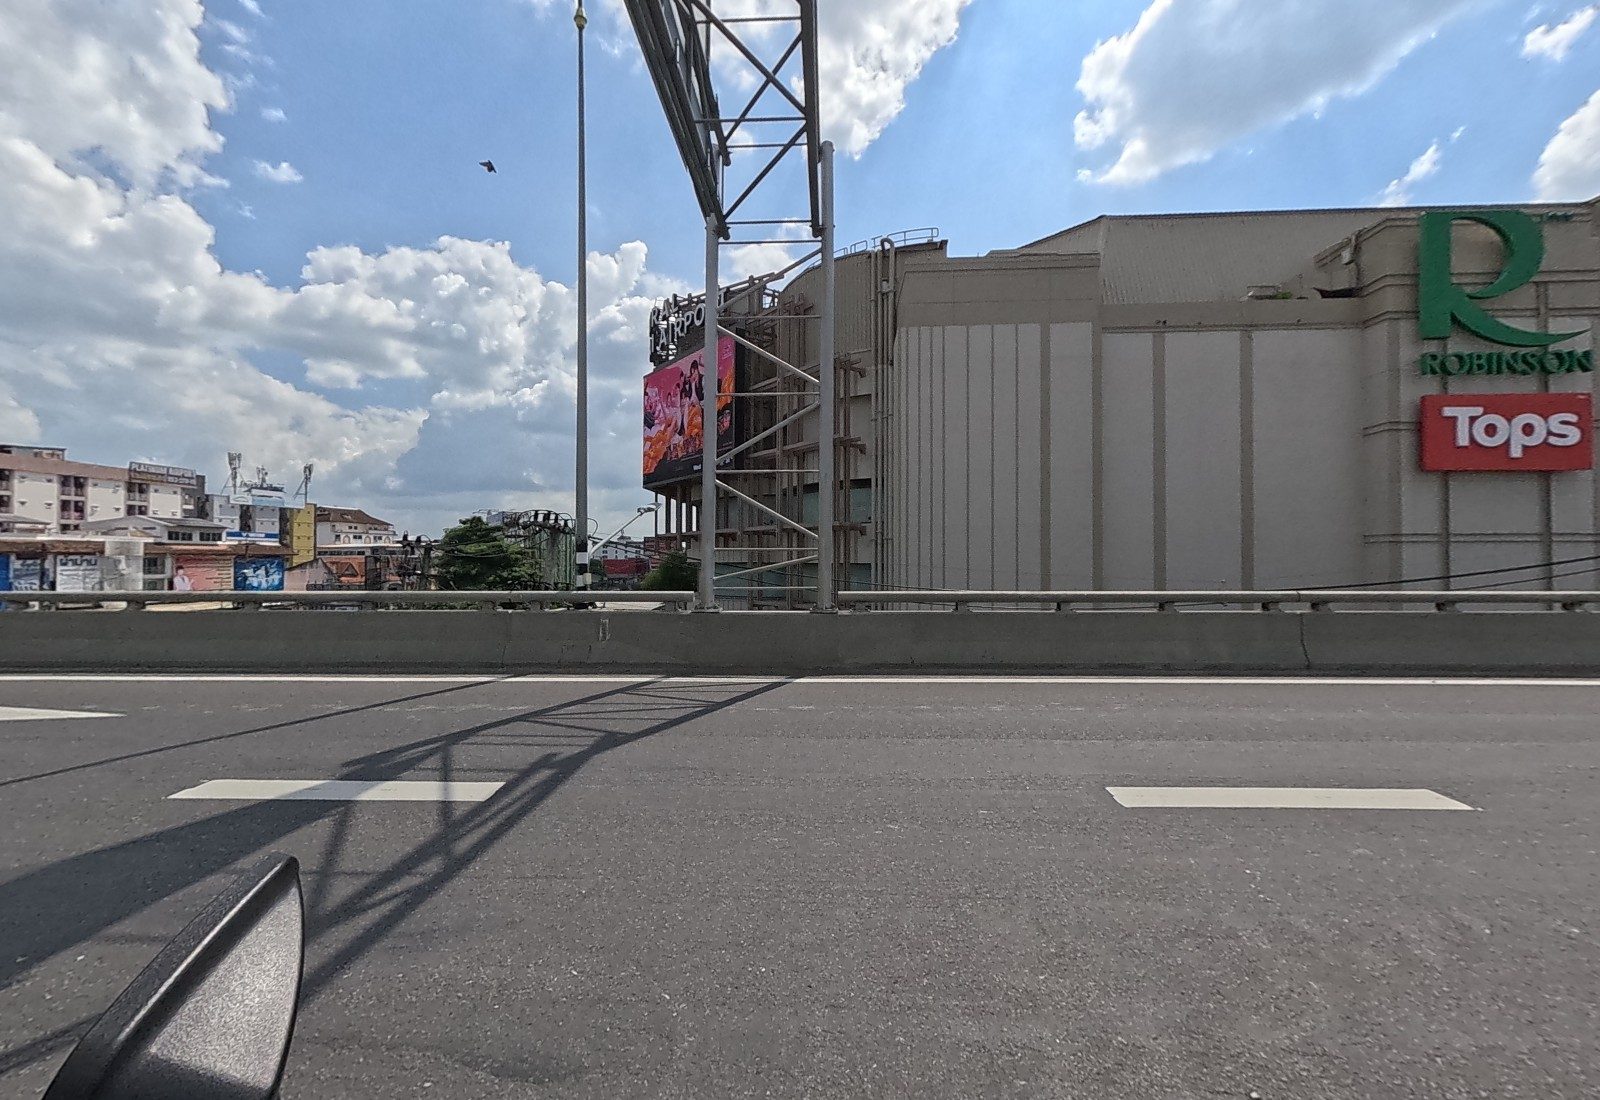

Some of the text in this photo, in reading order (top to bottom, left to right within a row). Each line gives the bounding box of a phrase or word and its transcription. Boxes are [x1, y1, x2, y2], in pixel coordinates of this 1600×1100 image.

[1420, 211, 1592, 347] R
[656, 288, 725, 349] AIRPOT
[1421, 350, 1594, 376] ROBINSON
[1441, 406, 1582, 458] Tops
